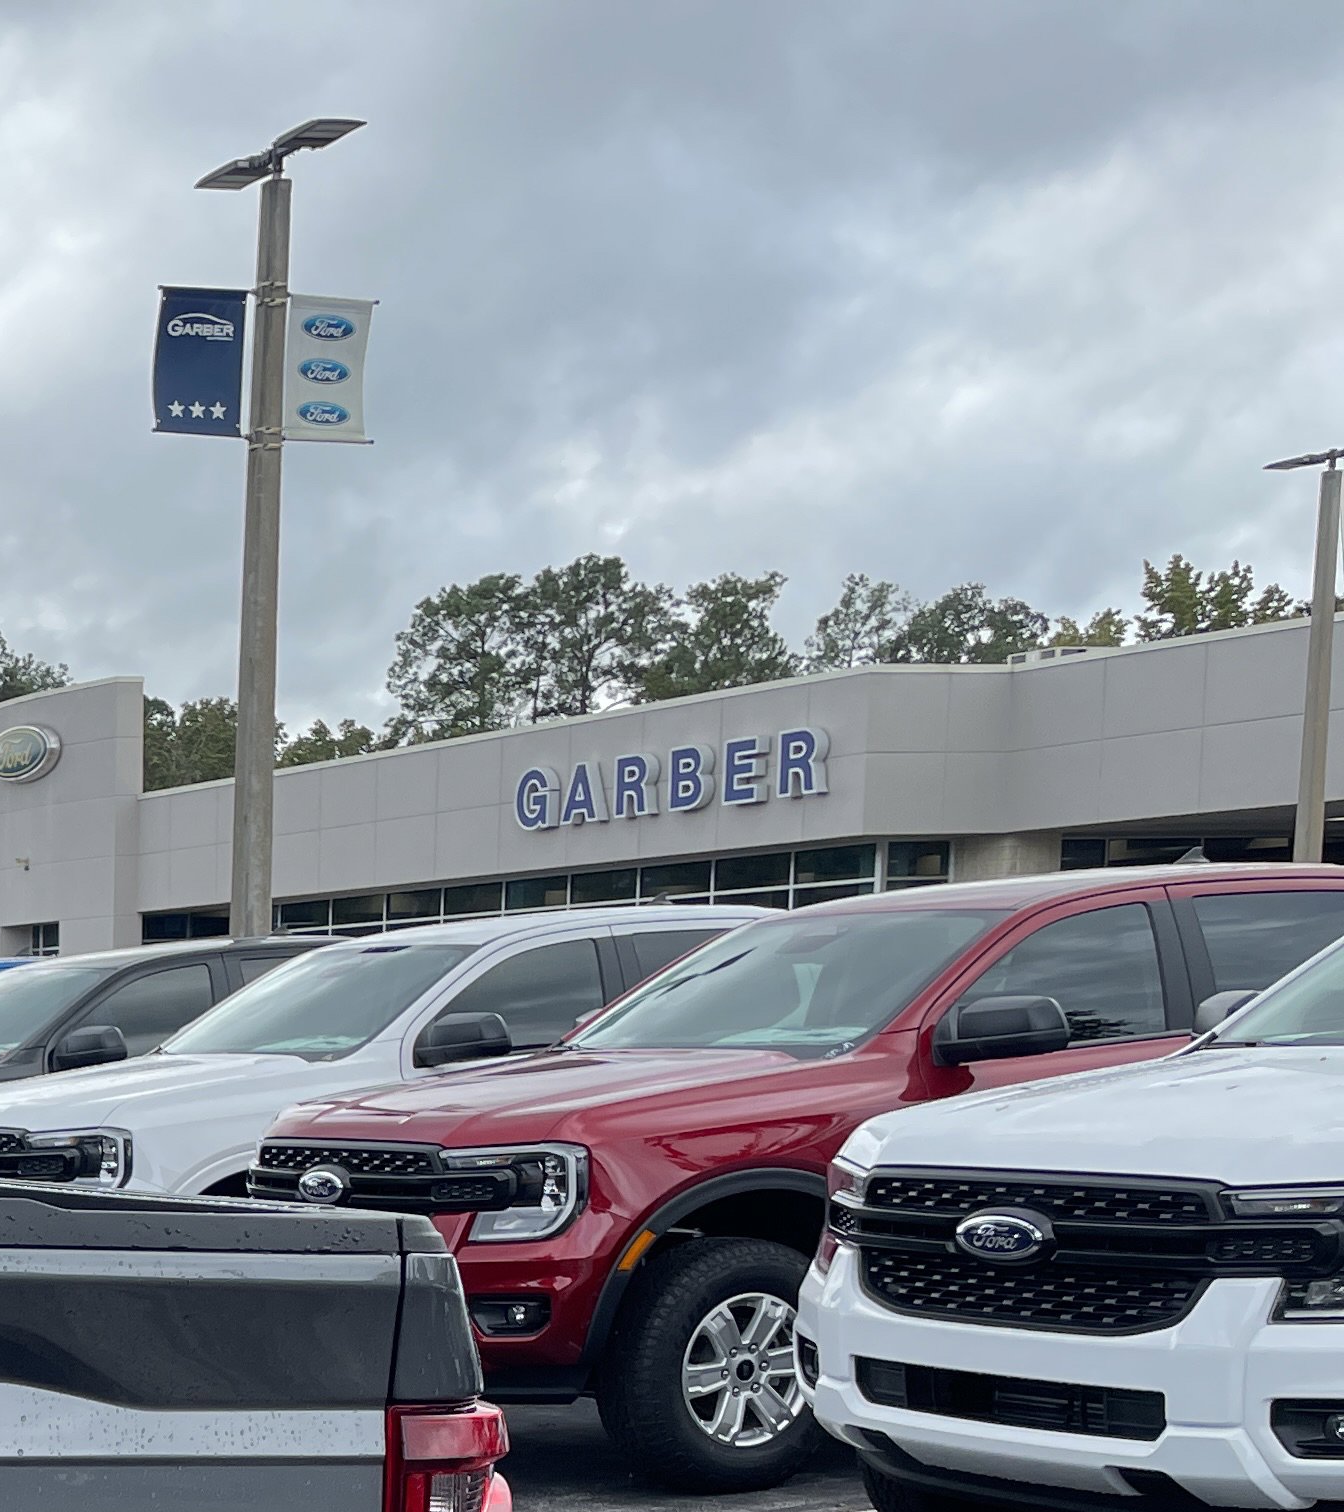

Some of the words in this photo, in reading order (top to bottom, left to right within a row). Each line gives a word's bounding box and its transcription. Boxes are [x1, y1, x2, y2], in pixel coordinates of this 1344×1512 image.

[166, 318, 235, 338] GARBER
[311, 319, 346, 337] Ford
[307, 362, 340, 381] Ford
[306, 407, 340, 423] Ford
[514, 726, 830, 831] GARBER
[972, 1223, 1021, 1250] Ford
